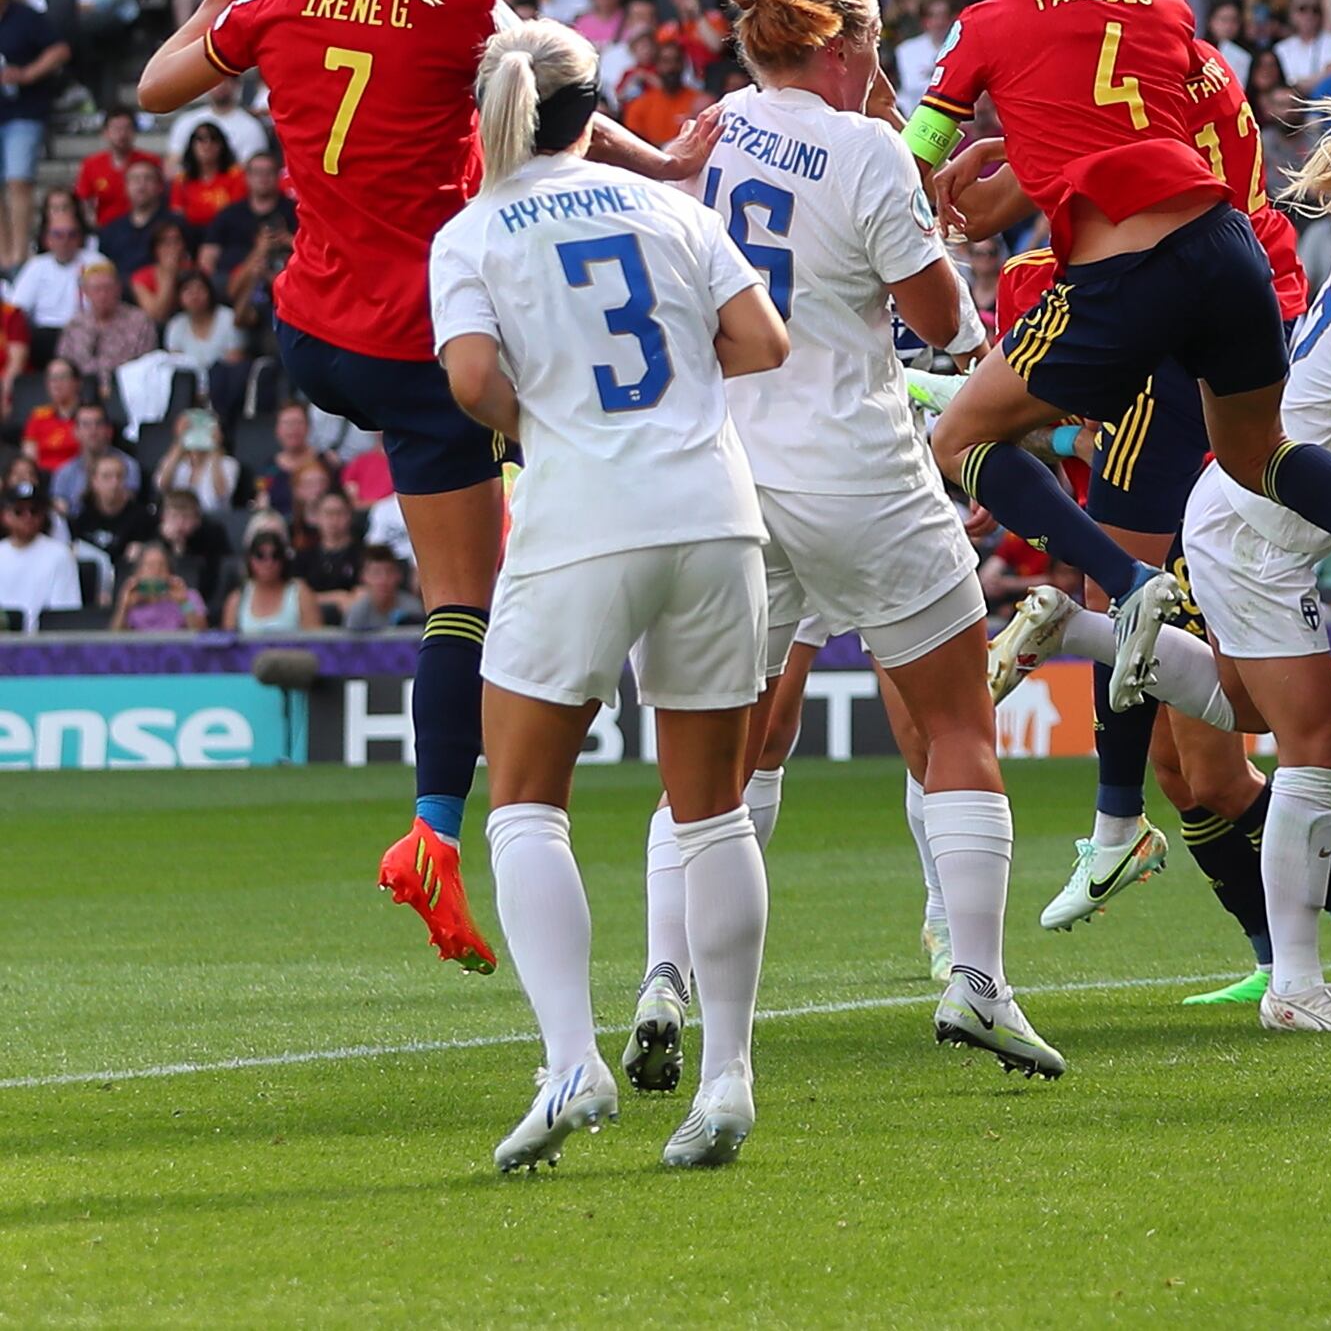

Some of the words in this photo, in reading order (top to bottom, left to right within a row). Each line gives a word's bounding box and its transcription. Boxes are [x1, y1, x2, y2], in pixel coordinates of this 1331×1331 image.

[323, 46, 373, 175] 7
[1093, 21, 1150, 131] 4
[498, 184, 655, 234] HYYRYNEN
[1194, 101, 1266, 215] 12
[555, 232, 676, 414] 3
